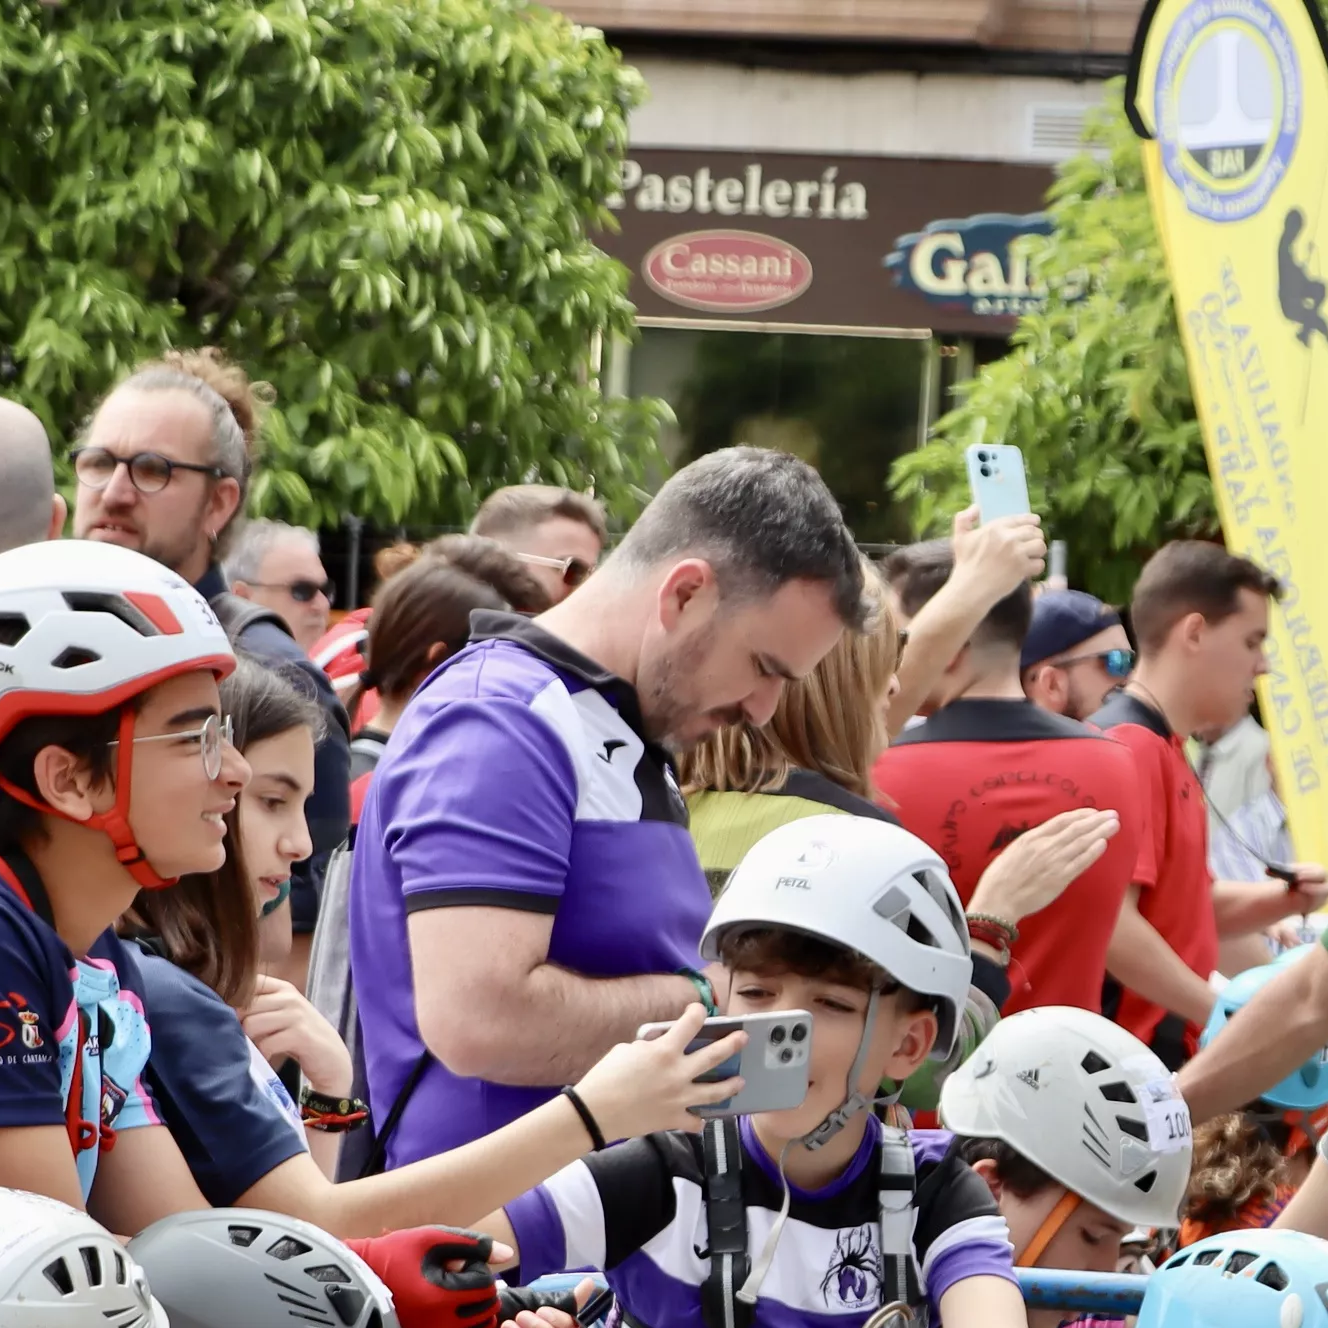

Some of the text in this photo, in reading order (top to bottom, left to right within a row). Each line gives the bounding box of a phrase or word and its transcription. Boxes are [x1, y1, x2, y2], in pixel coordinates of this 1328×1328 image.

[608, 160, 869, 219] Pastelería
[660, 243, 793, 279] Cassani
[776, 877, 812, 890] PETZL
[7, 1055, 17, 1065] DE
